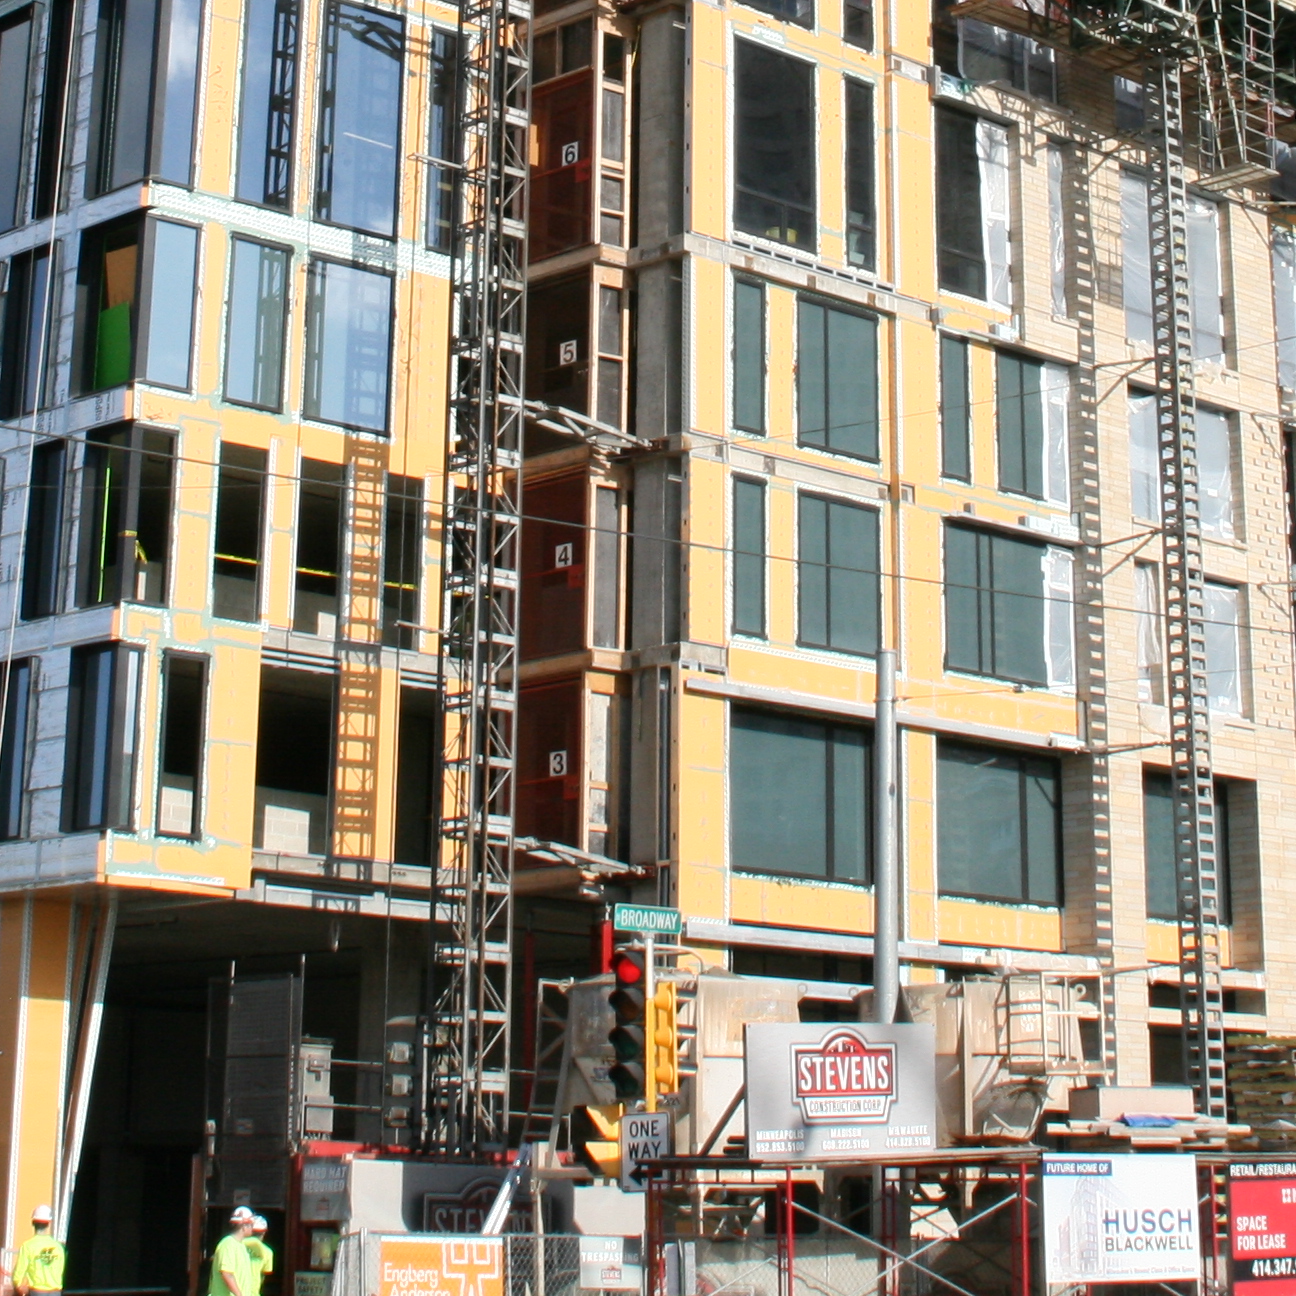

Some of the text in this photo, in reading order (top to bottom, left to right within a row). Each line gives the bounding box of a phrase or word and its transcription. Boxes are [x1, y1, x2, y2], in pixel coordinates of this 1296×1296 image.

[565, 145, 575, 164] 6
[564, 344, 573, 363] 5
[558, 546, 569, 565] 4
[552, 753, 564, 774] 3
[621, 909, 678, 930] BROADWAY
[800, 1055, 889, 1091] STEVENS
[809, 1099, 861, 1113] CONSTRUCTION
[629, 1120, 660, 1138] ONE
[756, 1129, 804, 1141] MINNEAPOLIS
[830, 1128, 862, 1138] MADISON
[888, 1125, 928, 1136] MILWAUKEE
[628, 1141, 661, 1160] WAY
[304, 1166, 327, 1180] HARD
[1046, 1162, 1109, 1173] FUTURE HOME OF
[304, 1179, 346, 1193] REQUIRED
[1103, 1208, 1192, 1234] HUSCH
[1236, 1215, 1267, 1231] SPACE
[605, 1240, 618, 1250] NO
[1105, 1235, 1194, 1252] BLACKWELL
[1237, 1234, 1286, 1250] FOR LEASE
[384, 1262, 439, 1288] Engberg
